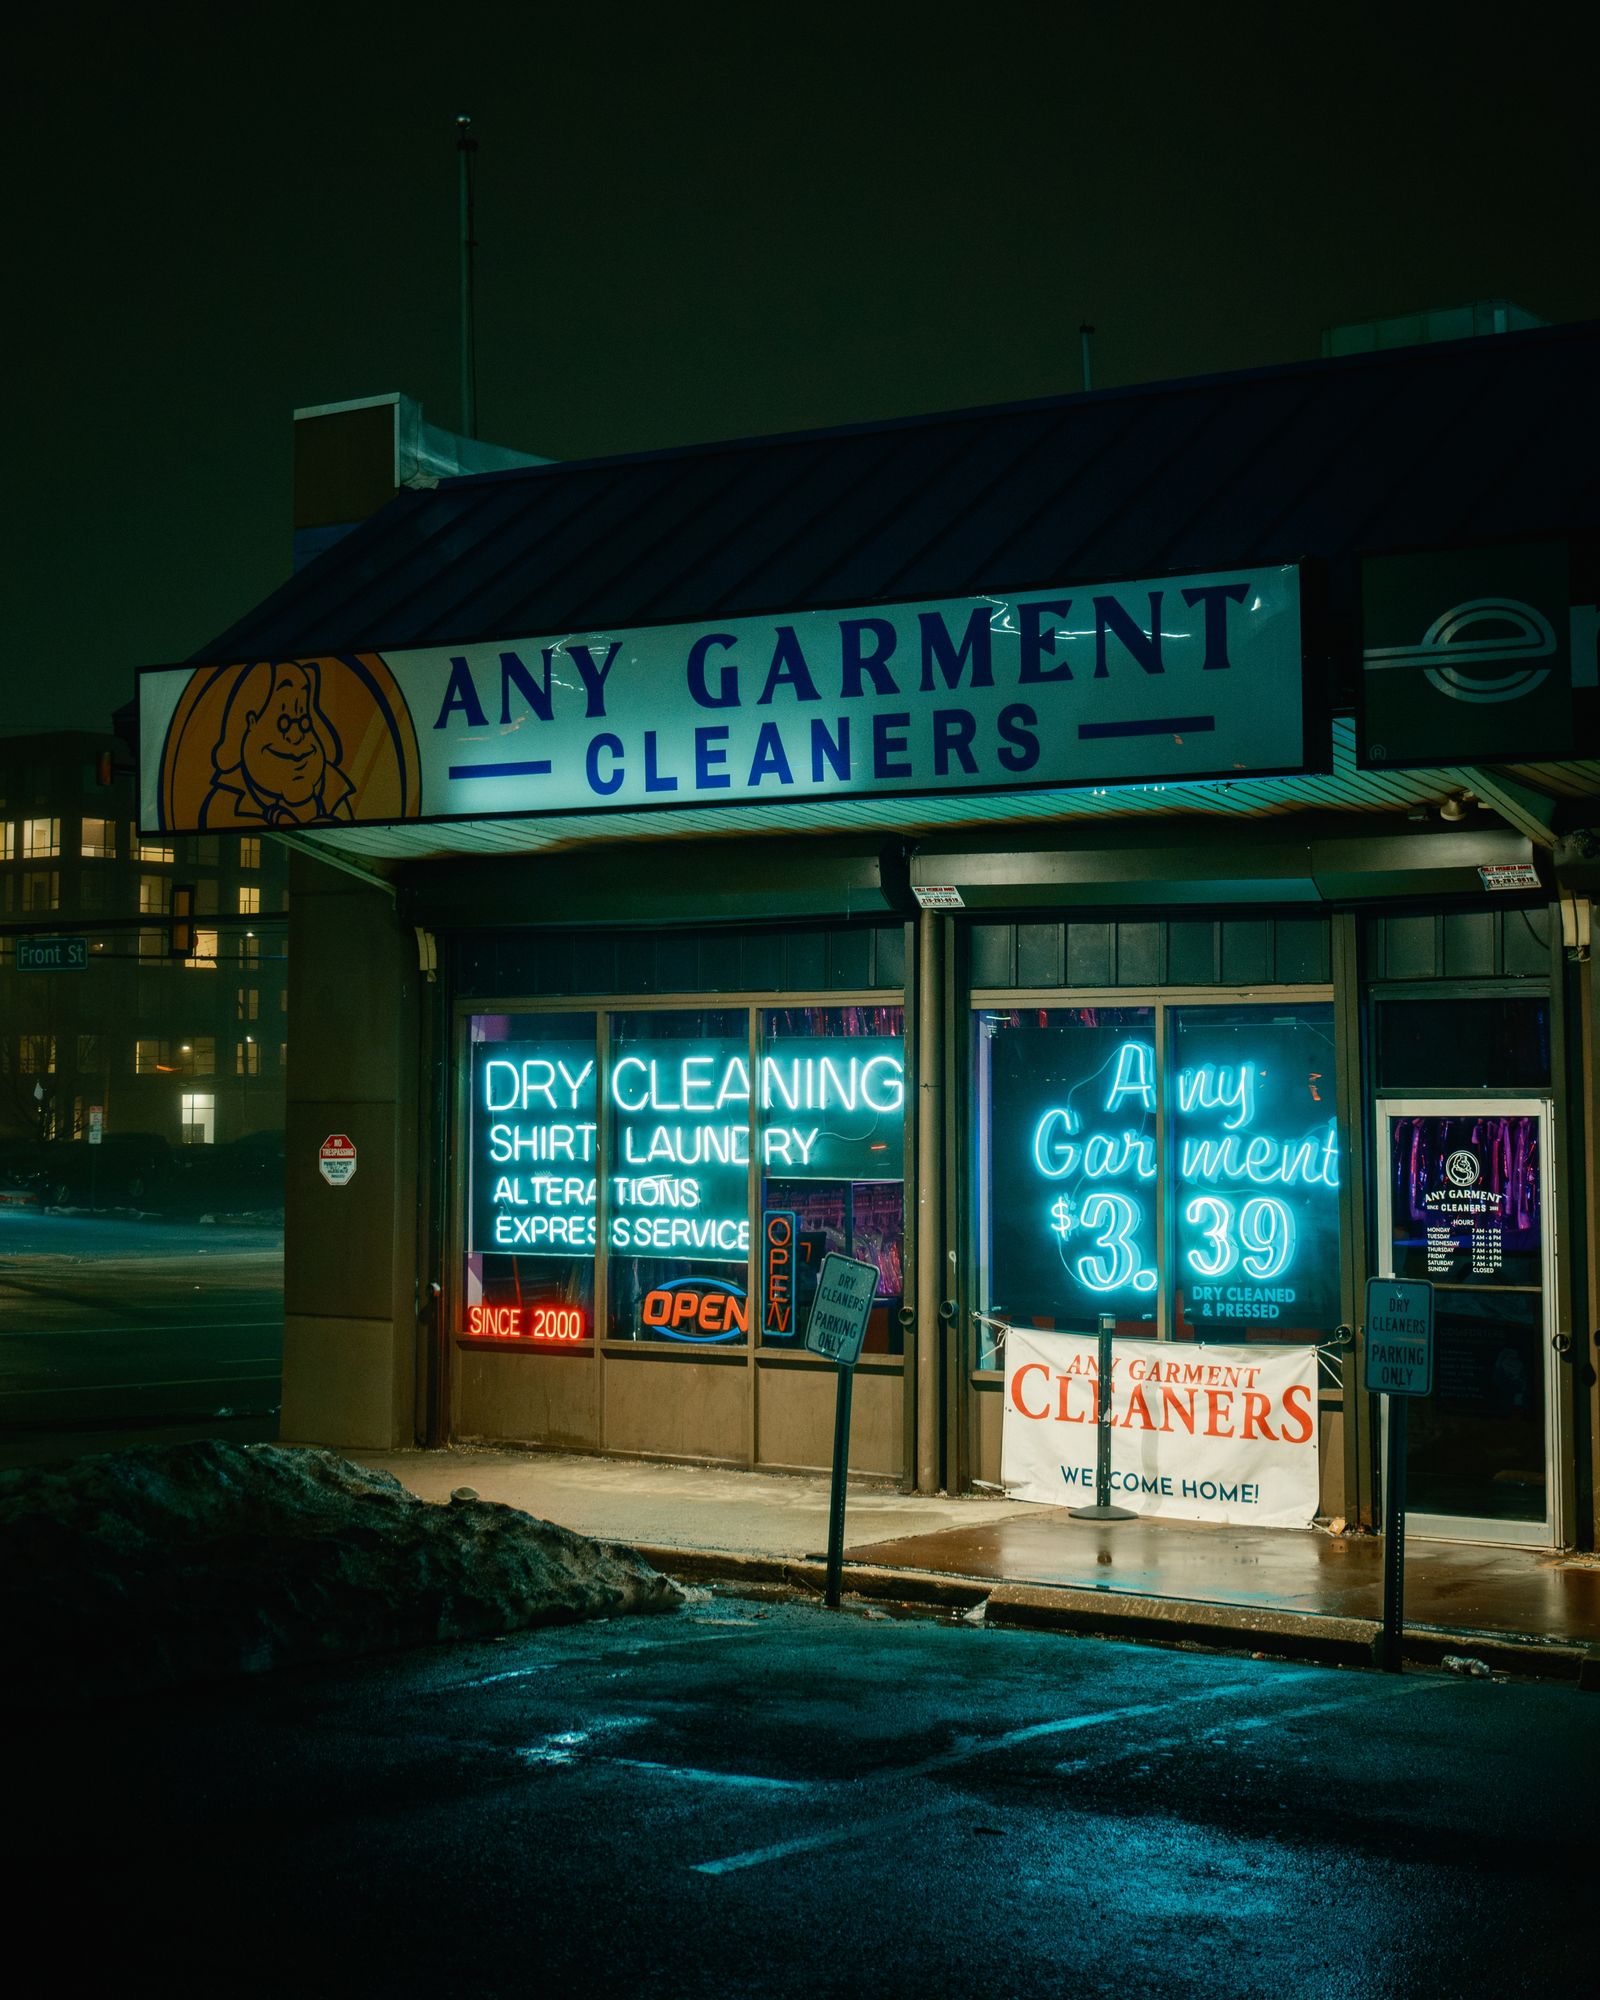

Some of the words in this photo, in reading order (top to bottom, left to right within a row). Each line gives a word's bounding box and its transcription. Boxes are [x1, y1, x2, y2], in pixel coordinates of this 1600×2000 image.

[433, 641, 623, 730] ANY
[686, 582, 1251, 709] GARMENT
[586, 703, 1040, 796] CLEANERS
[20, 945, 61, 965] Front
[68, 945, 83, 963] St
[486, 1059, 594, 1111] DRY
[612, 1056, 904, 1112] CLEANING
[1106, 1042, 1250, 1129] Any
[323, 1148, 354, 1156] TRESPASSING
[334, 1139, 343, 1147] NO
[490, 1124, 597, 1162] SHIRT
[1035, 1109, 1339, 1187] Garment
[493, 1176, 699, 1208] ALTERATIONS
[1425, 1190, 1446, 1203] ANY
[1449, 1189, 1502, 1203] GARMENT
[1441, 1203, 1486, 1212] CLEANERS
[767, 1217, 791, 1332] OPEN
[838, 1273, 857, 1289] DRY
[821, 1286, 866, 1312] CLEANERS
[1193, 1286, 1222, 1300] DRY
[1227, 1287, 1296, 1303] CLEANED
[1389, 1298, 1410, 1312] DRY
[470, 1308, 520, 1337] SINCE
[534, 1310, 581, 1340] 2000
[643, 1290, 748, 1332] OPEN
[1203, 1304, 1215, 1317] &
[1217, 1304, 1280, 1319] PRESSED
[815, 1311, 858, 1338] PARKING
[1372, 1316, 1426, 1334] CLEANERS
[818, 1332, 846, 1354] ONLY
[1372, 1344, 1425, 1366] PARKING
[1129, 1358, 1261, 1389] GARMENT
[1382, 1366, 1414, 1386] ONLY
[1060, 1465, 1174, 1497] WECOME
[1183, 1479, 1260, 1504] HOME!
